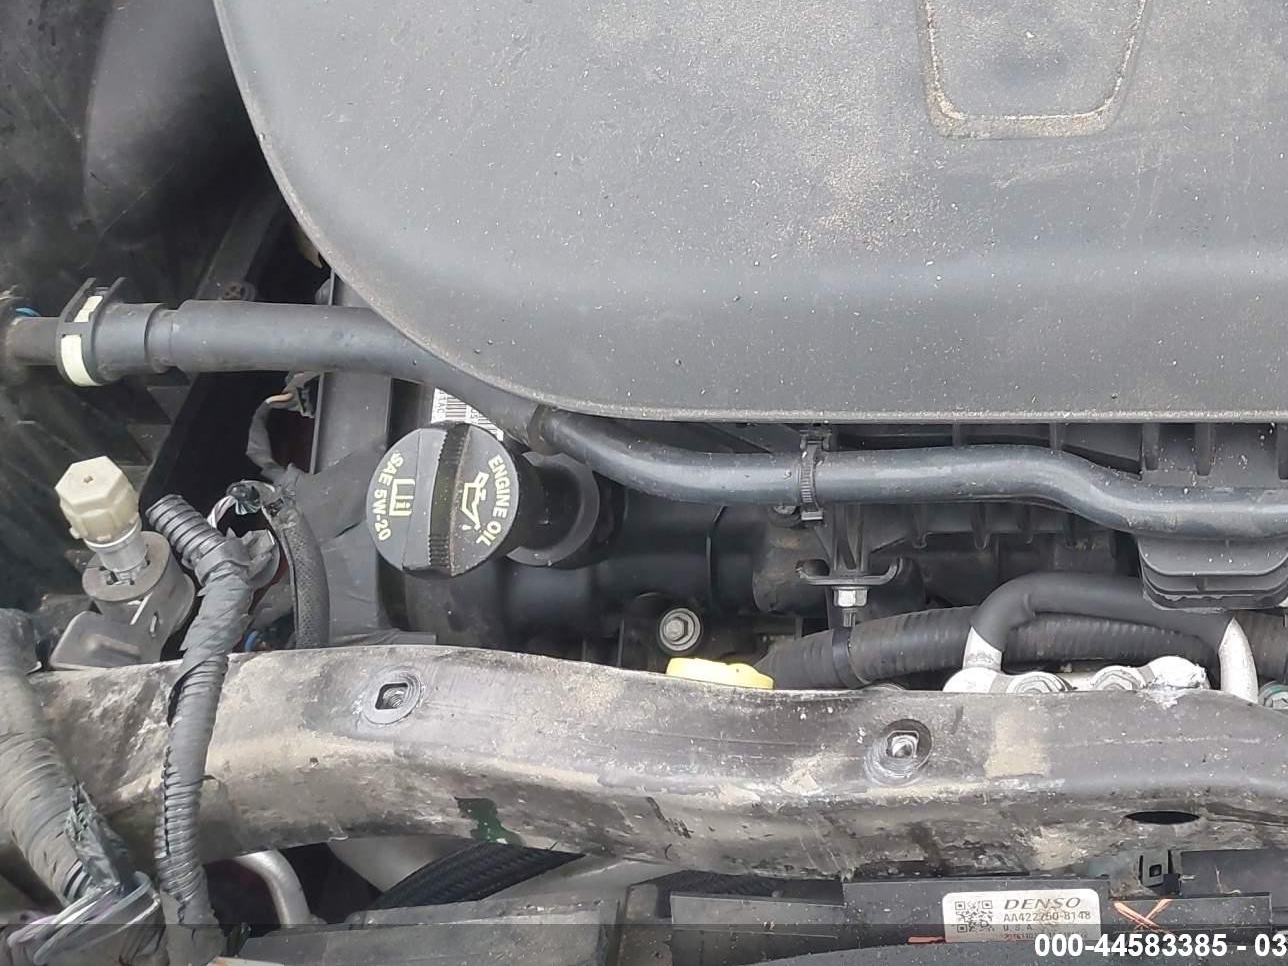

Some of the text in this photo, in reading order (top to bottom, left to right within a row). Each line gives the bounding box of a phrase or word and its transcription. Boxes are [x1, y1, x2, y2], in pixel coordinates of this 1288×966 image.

[373, 452, 404, 541] SAE 5W-20
[476, 454, 511, 546] ENGINE OIL
[1004, 897, 1081, 910] DENSO
